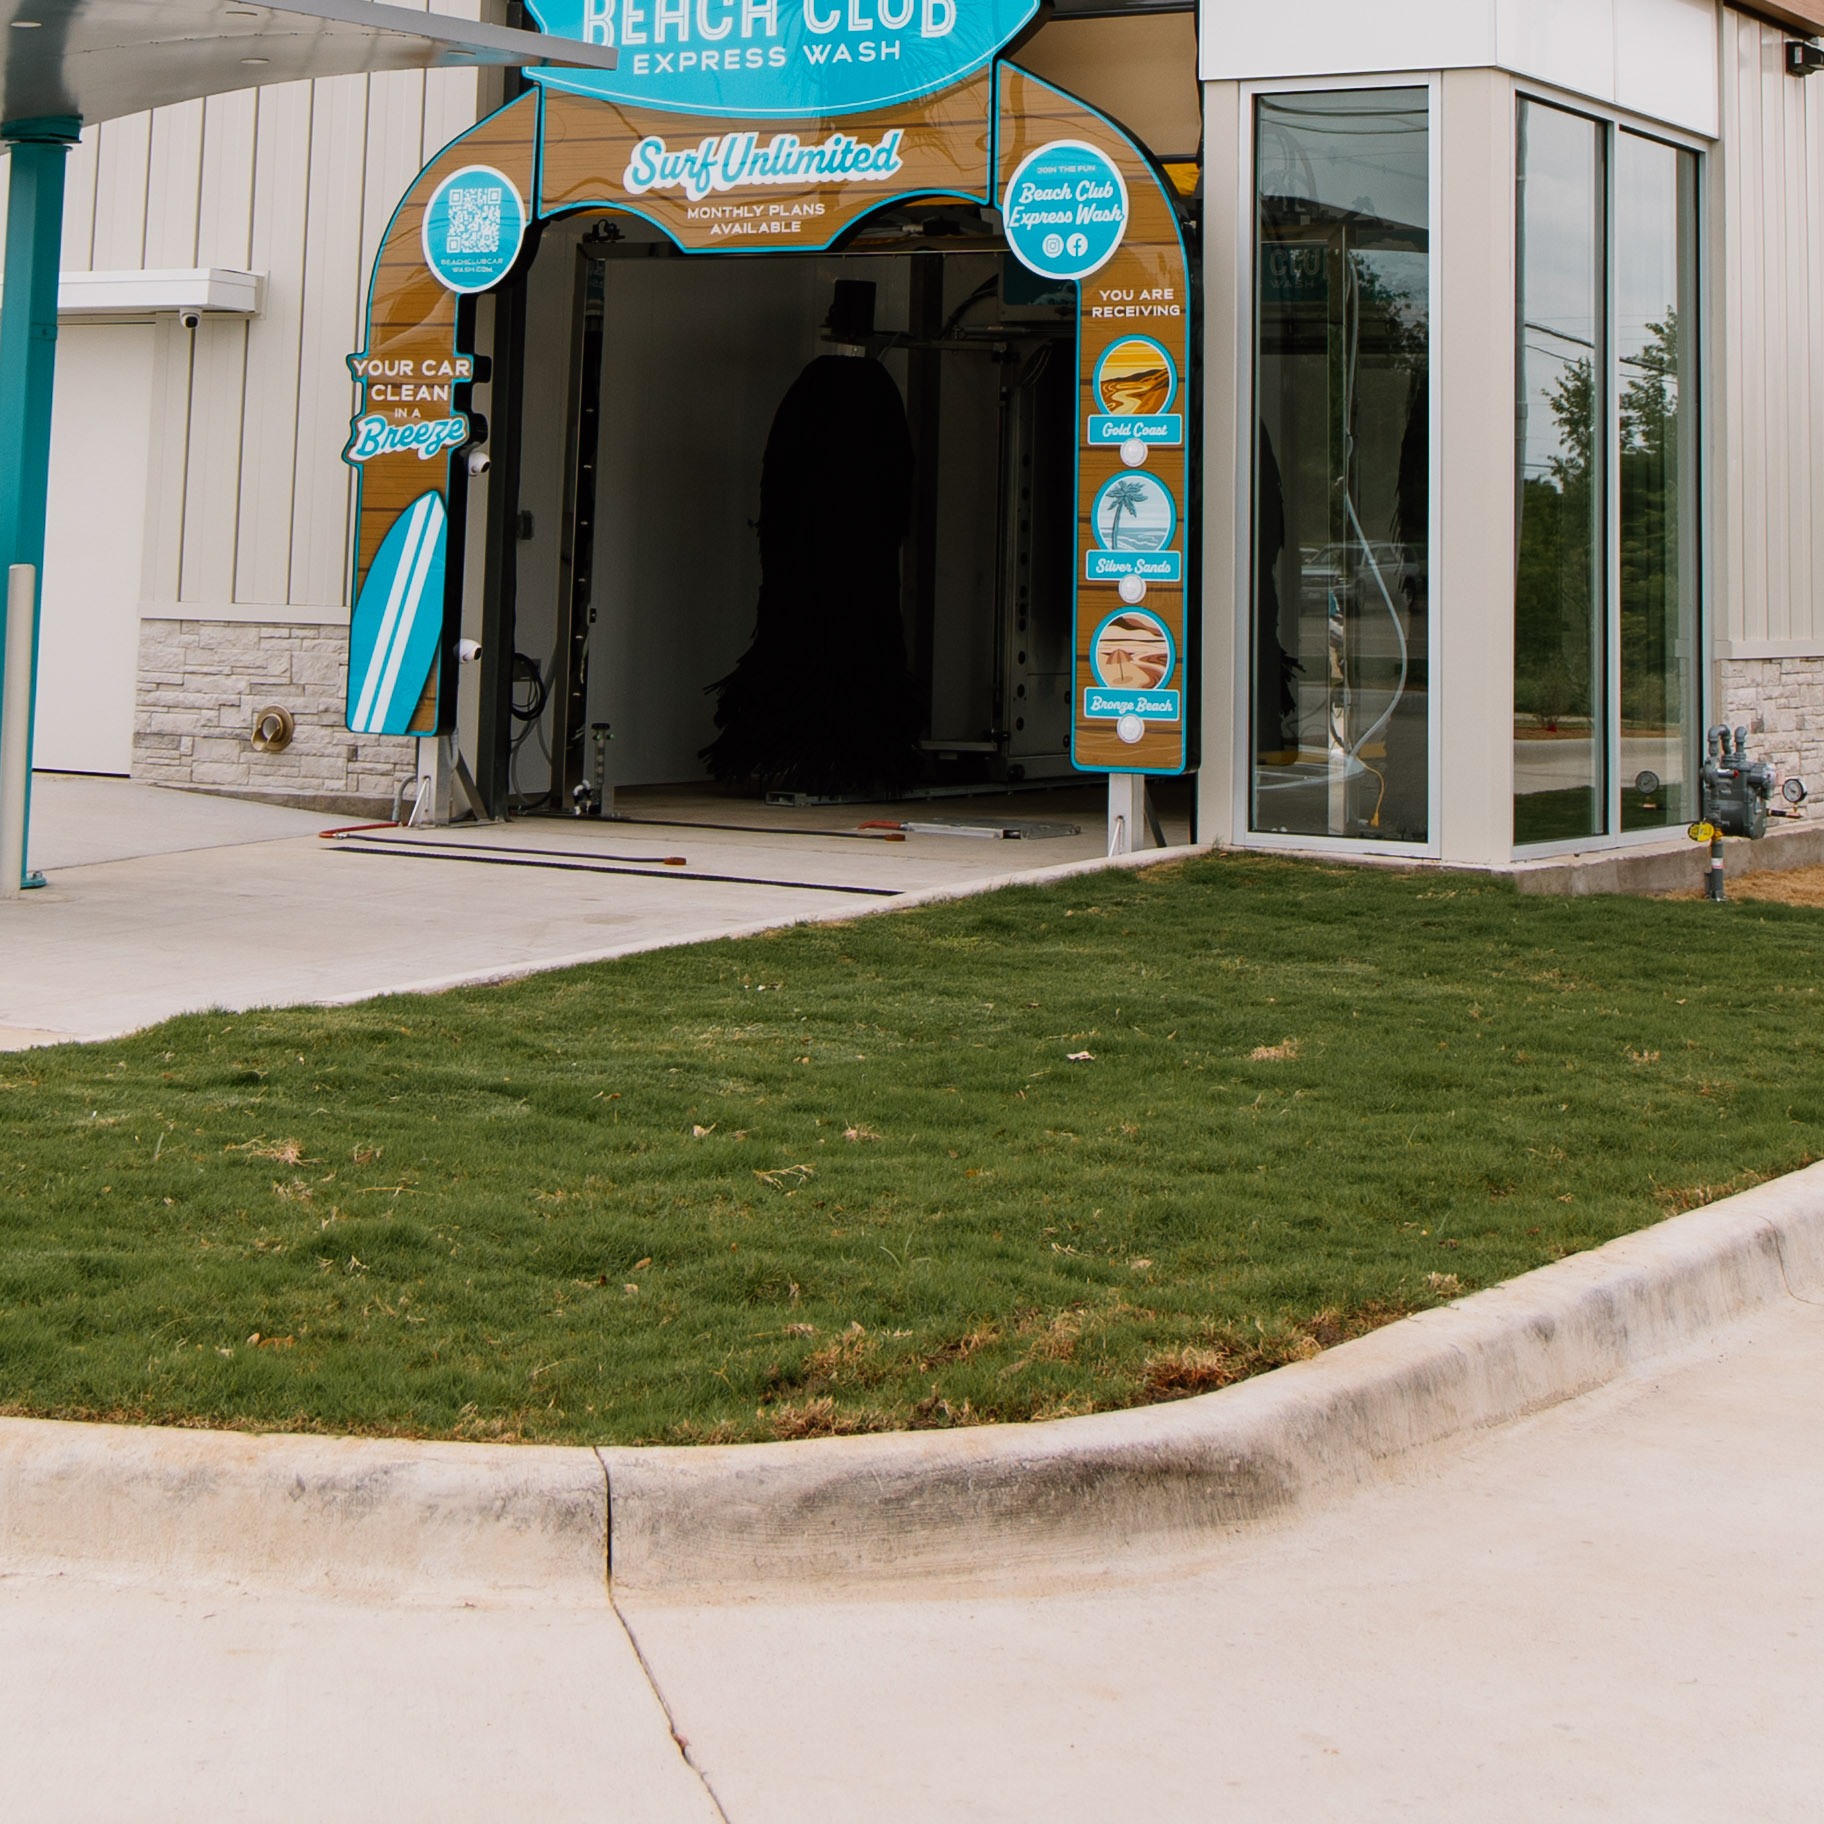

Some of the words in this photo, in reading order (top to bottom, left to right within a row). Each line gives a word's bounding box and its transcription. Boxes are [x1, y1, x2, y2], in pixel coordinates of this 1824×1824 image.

[633, 46, 787, 74] EXPRESS
[803, 40, 901, 65] WASH
[627, 135, 719, 197] Surf
[719, 132, 901, 187] Unlimited
[1037, 166, 1056, 174] JOIN
[1058, 165, 1075, 173] THE
[1018, 181, 1072, 204] Beach
[1075, 179, 1113, 202] Club
[687, 205, 765, 219] MONTHLY
[768, 203, 826, 216] PLANS
[1009, 206, 1073, 230] Express
[1075, 202, 1123, 225] Wash
[710, 221, 801, 235] AVAILABLE
[1270, 248, 1326, 276] CLU
[1271, 279, 1315, 289] WASH
[1099, 289, 1134, 302] YOU
[1139, 288, 1174, 301] ARE
[1092, 304, 1181, 318] RECEIVING
[352, 359, 414, 376] YOUR
[421, 359, 471, 376] CAR
[370, 384, 449, 401] CLEAN
[394, 407, 408, 418] IN
[411, 407, 421, 418] A
[350, 415, 466, 459] Breeze
[1102, 422, 1132, 438] Gold
[1133, 422, 1168, 437] Coast
[1095, 558, 1133, 574] Silver
[1134, 558, 1171, 575] Sands
[1090, 695, 1134, 714] Bronze
[1135, 697, 1173, 713] Beach
